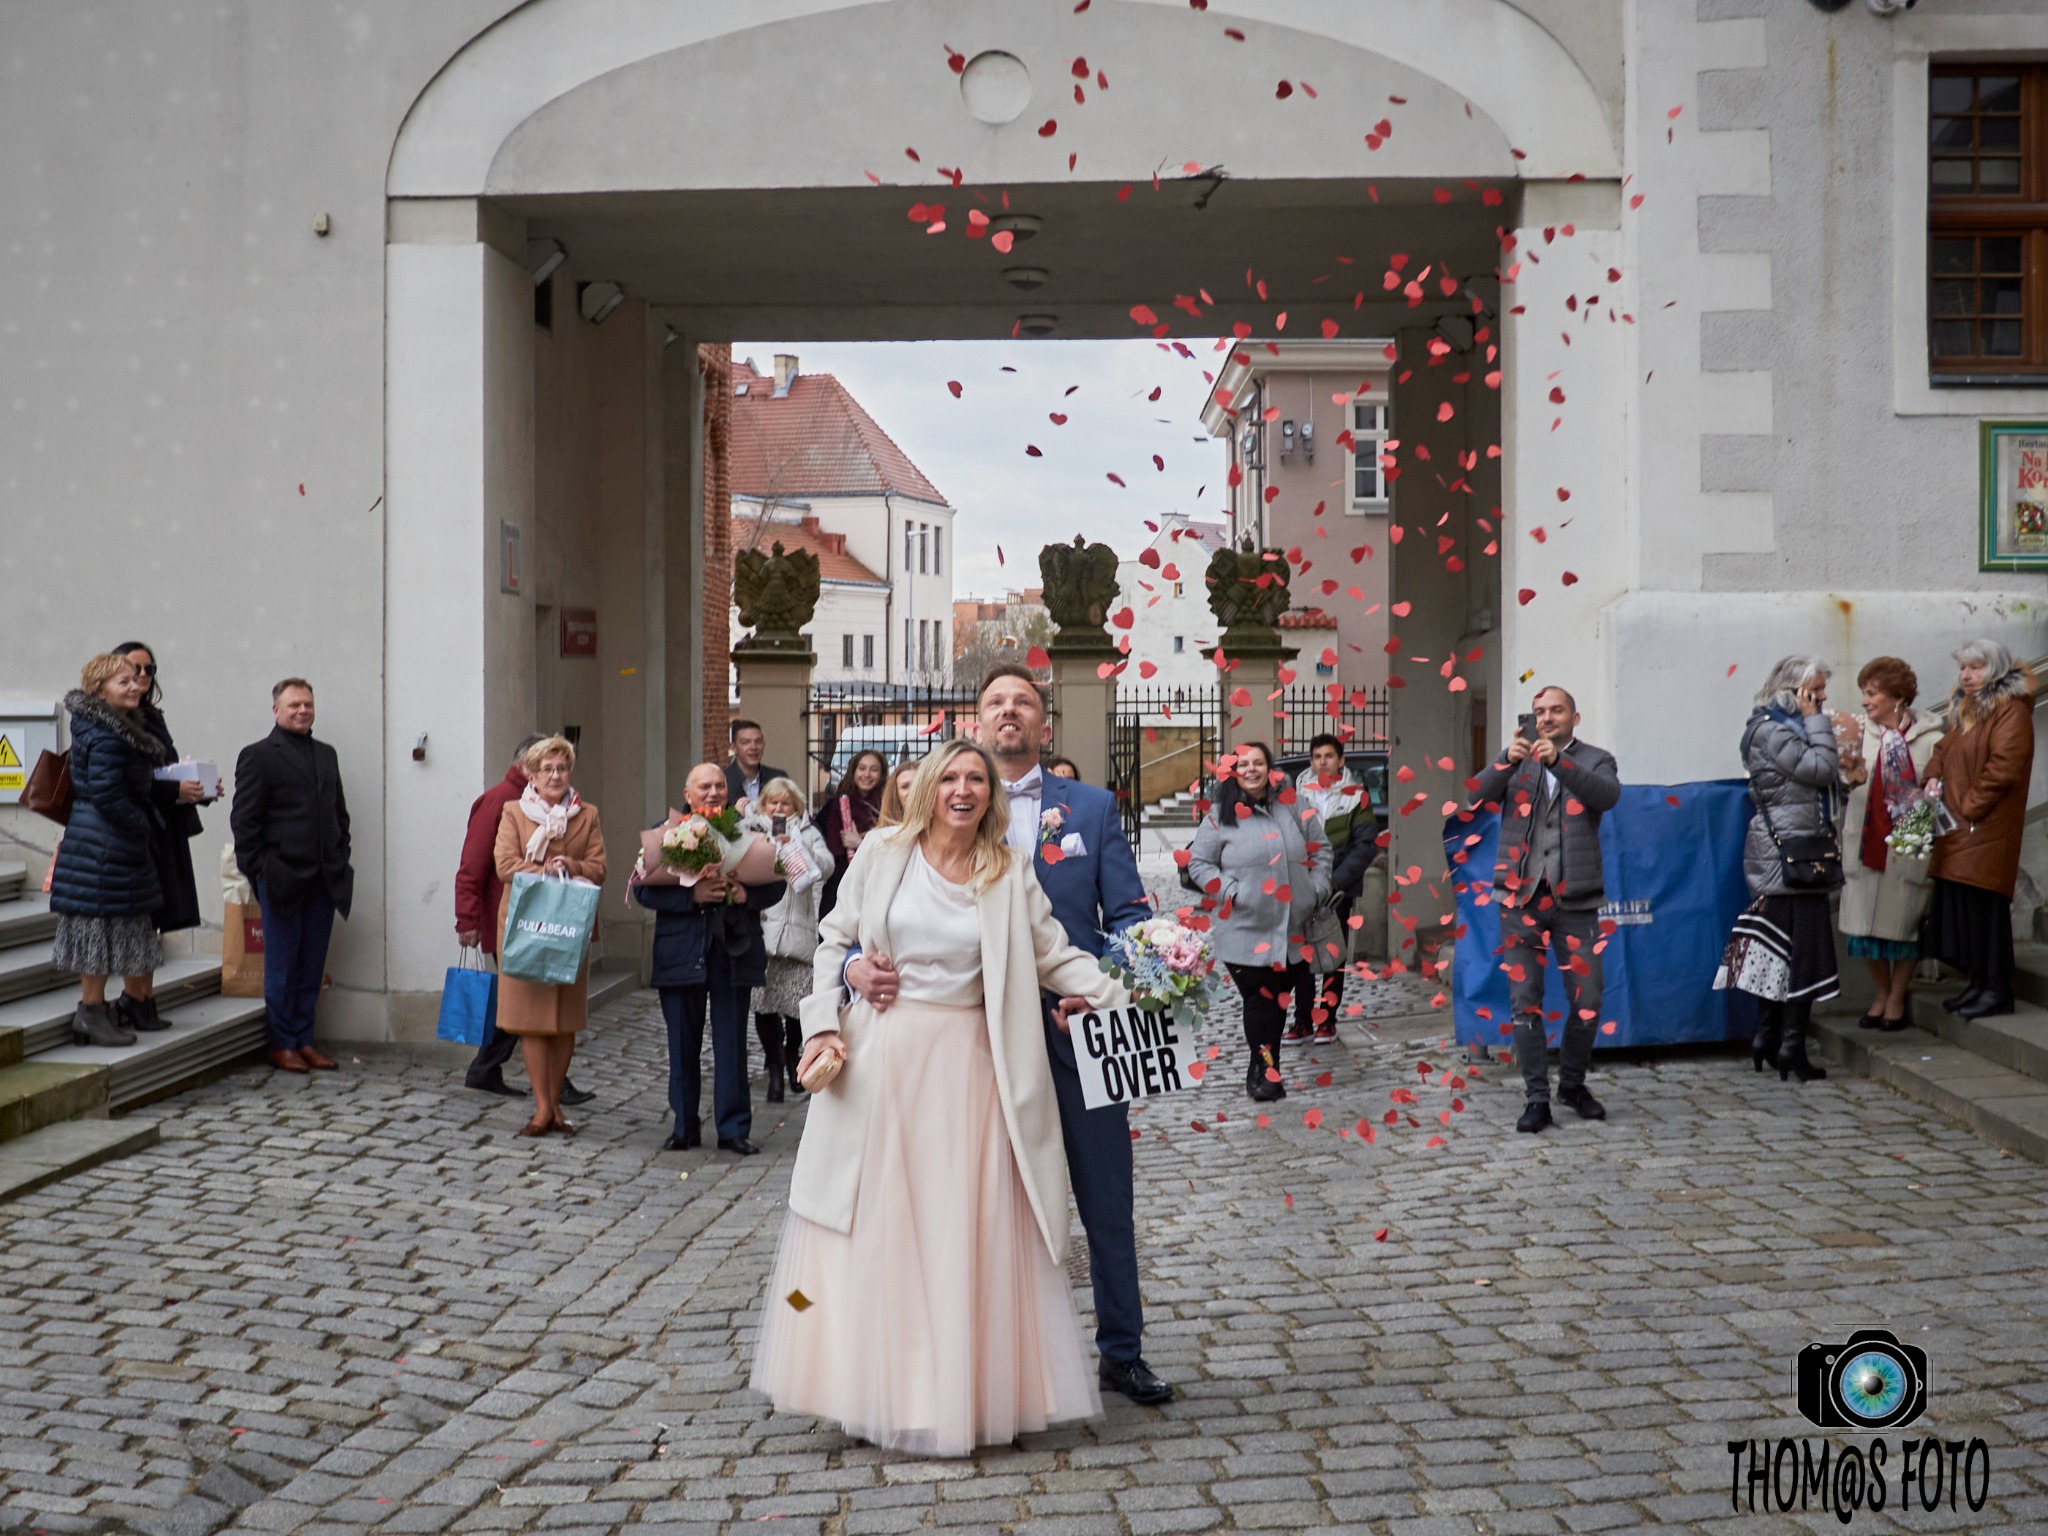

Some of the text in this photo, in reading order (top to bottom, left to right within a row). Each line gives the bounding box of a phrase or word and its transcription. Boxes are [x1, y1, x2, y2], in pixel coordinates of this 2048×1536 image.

[2021, 451, 2042, 467] Na
[1082, 1001, 1179, 1059] GAME
[1101, 1047, 1182, 1103] OVER
